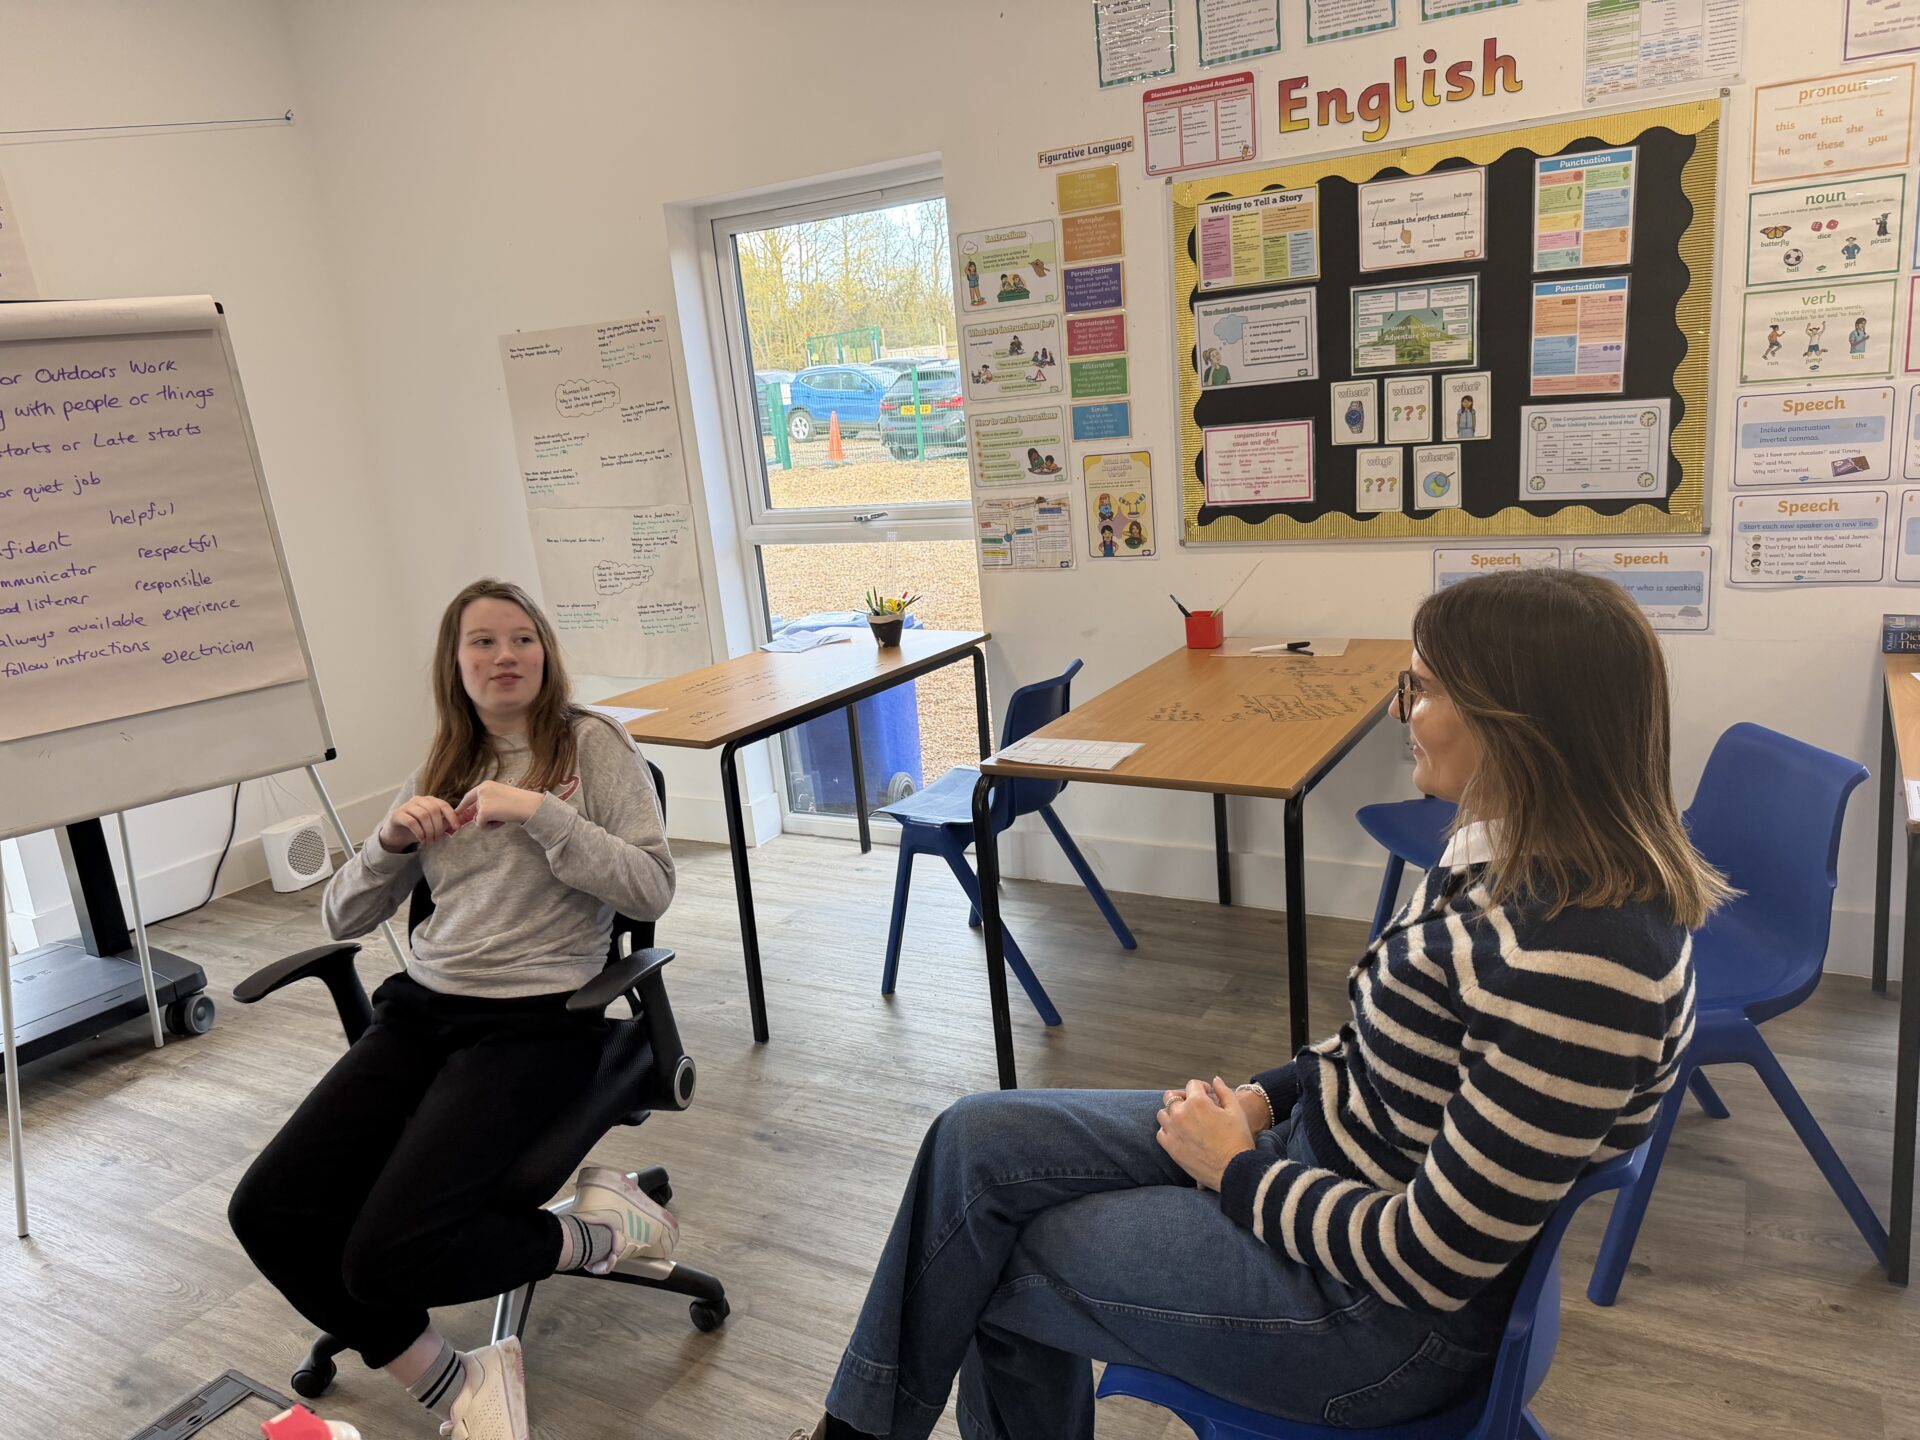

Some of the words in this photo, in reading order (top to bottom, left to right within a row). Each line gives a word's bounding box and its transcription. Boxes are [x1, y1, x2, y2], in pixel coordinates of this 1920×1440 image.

[1151, 89, 1182, 99] Discussions
[1188, 82, 1214, 92] Balanced
[1214, 77, 1245, 88] Arguments
[1278, 37, 1523, 142] English
[1798, 80, 1869, 103] pronoun
[1775, 121, 1796, 132] this
[1820, 114, 1843, 125] that
[1875, 108, 1884, 117] it
[1798, 131, 1818, 141] one
[1845, 124, 1864, 135] she
[1039, 148, 1085, 165] Figurative
[1087, 139, 1133, 156] Language
[1778, 147, 1791, 157] he
[1816, 140, 1845, 151] these
[1867, 134, 1888, 146] you
[1559, 155, 1611, 168] Punctuation
[1210, 203, 1242, 214] Writing
[1243, 201, 1252, 209] to
[1253, 197, 1270, 207] Tell
[1279, 194, 1303, 204] Story
[1805, 191, 1847, 206] noun
[1405, 216, 1416, 224] the
[1417, 214, 1440, 224] perfect
[1760, 238, 1790, 248] butterfly
[1870, 237, 1892, 246] pirate
[1817, 232, 1832, 240] dice
[1070, 266, 1113, 279] Personification
[1786, 266, 1800, 274] ball
[1844, 260, 1857, 269] girl
[1555, 282, 1606, 293] Punctuation
[1801, 290, 1836, 306] verb
[1851, 353, 1865, 361] talk
[35, 366, 118, 384] Outdoors
[129, 360, 178, 375] Work
[1337, 386, 1371, 399] when?
[1392, 385, 1426, 397] what?
[1452, 381, 1481, 394] who?
[15, 400, 56, 418] with
[63, 395, 122, 421] people
[129, 393, 151, 406] or
[156, 385, 214, 409] things
[1782, 395, 1846, 416] Speech
[1760, 425, 1786, 434] Include
[1787, 424, 1831, 434] punctuation
[1855, 421, 1868, 429] the
[0, 442, 52, 458] tarts
[61, 440, 81, 453] or
[93, 432, 139, 449] Late
[147, 423, 202, 441] starts
[1759, 435, 1788, 444] inverted
[1788, 434, 1820, 443] commas.
[1366, 456, 1393, 469] why?
[1418, 452, 1456, 465] where?
[23, 479, 64, 503] quiet
[72, 471, 102, 496] job
[109, 502, 175, 527] helpful
[1777, 498, 1840, 517] Speech
[1743, 523, 1760, 531] Start
[1762, 522, 1778, 530] each
[1796, 522, 1823, 530] speaker
[0, 531, 73, 560] fident
[138, 534, 219, 561] respectful
[1470, 553, 1521, 569] Speech
[1613, 551, 1668, 568] Speech
[135, 569, 213, 594] responsible
[1636, 583, 1655, 592] who
[1656, 584, 1663, 592] is
[1665, 584, 1703, 593] speaking.
[28, 593, 90, 613] listener
[162, 599, 241, 622] experience
[68, 613, 149, 634] available
[1, 661, 49, 678] follow
[55, 640, 151, 667] instructions
[161, 640, 256, 665] electrician
